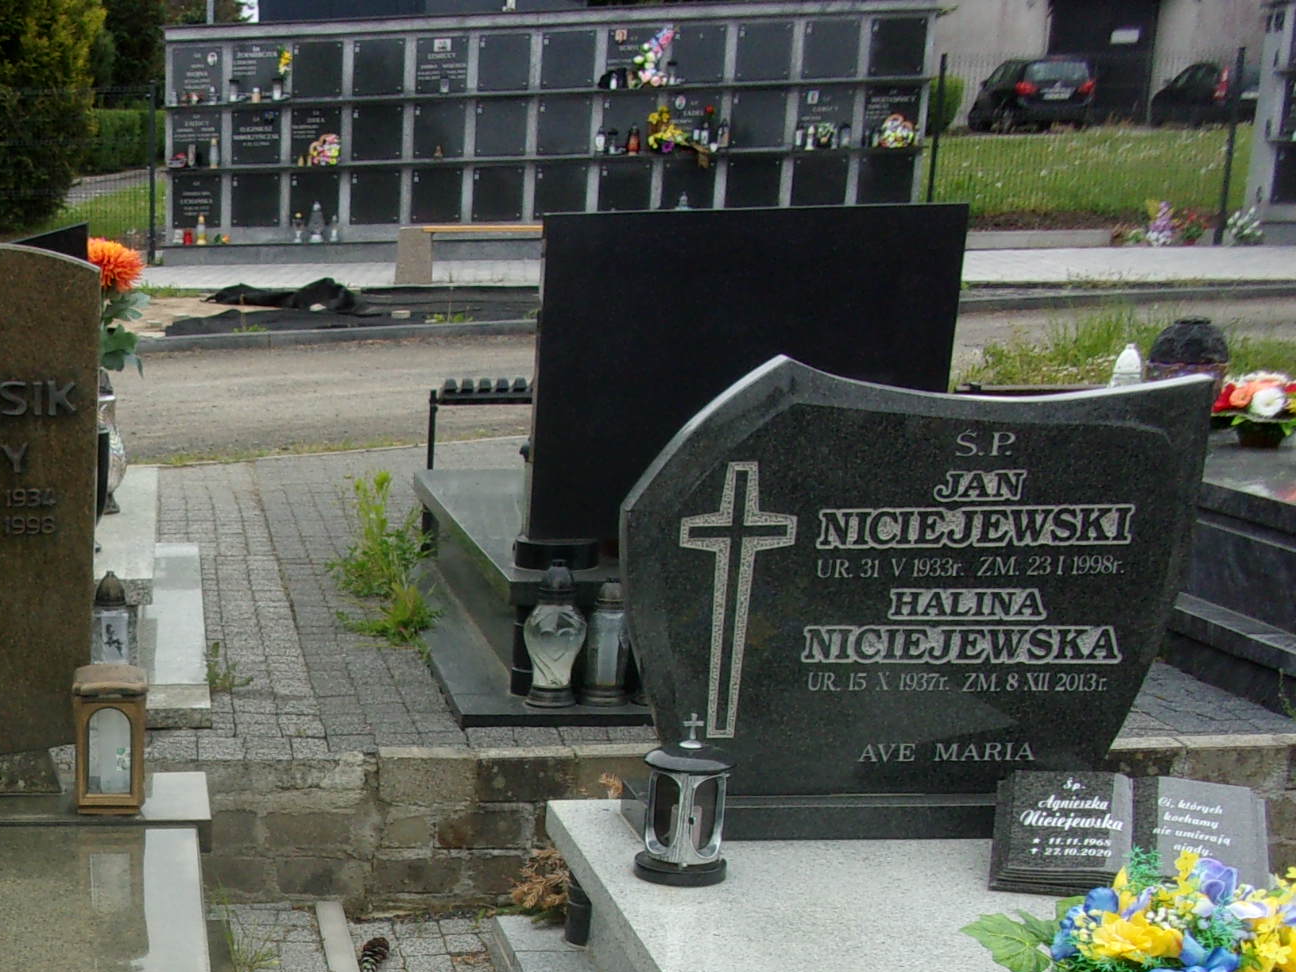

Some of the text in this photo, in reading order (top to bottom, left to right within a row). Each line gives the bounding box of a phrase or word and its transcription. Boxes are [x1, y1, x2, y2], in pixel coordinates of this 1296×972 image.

[934, 470, 1027, 502] JAN
[816, 505, 1135, 549] NICIEJEWSKI
[817, 555, 1125, 578] UR. 31 V 1933r. ZM. 23 I 1998r.
[888, 588, 1047, 621] HALINA
[801, 625, 1123, 664] NICIEJEWSKA
[848, 672, 867, 691] 15
[899, 672, 950, 692] 1937r.
[1006, 672, 1019, 691] 8
[1024, 672, 1051, 691] XII
[857, 742, 1035, 762] AVE MARIA
[1038, 794, 1110, 811] Agnieszka
[1020, 809, 1124, 832] Niciejewska
